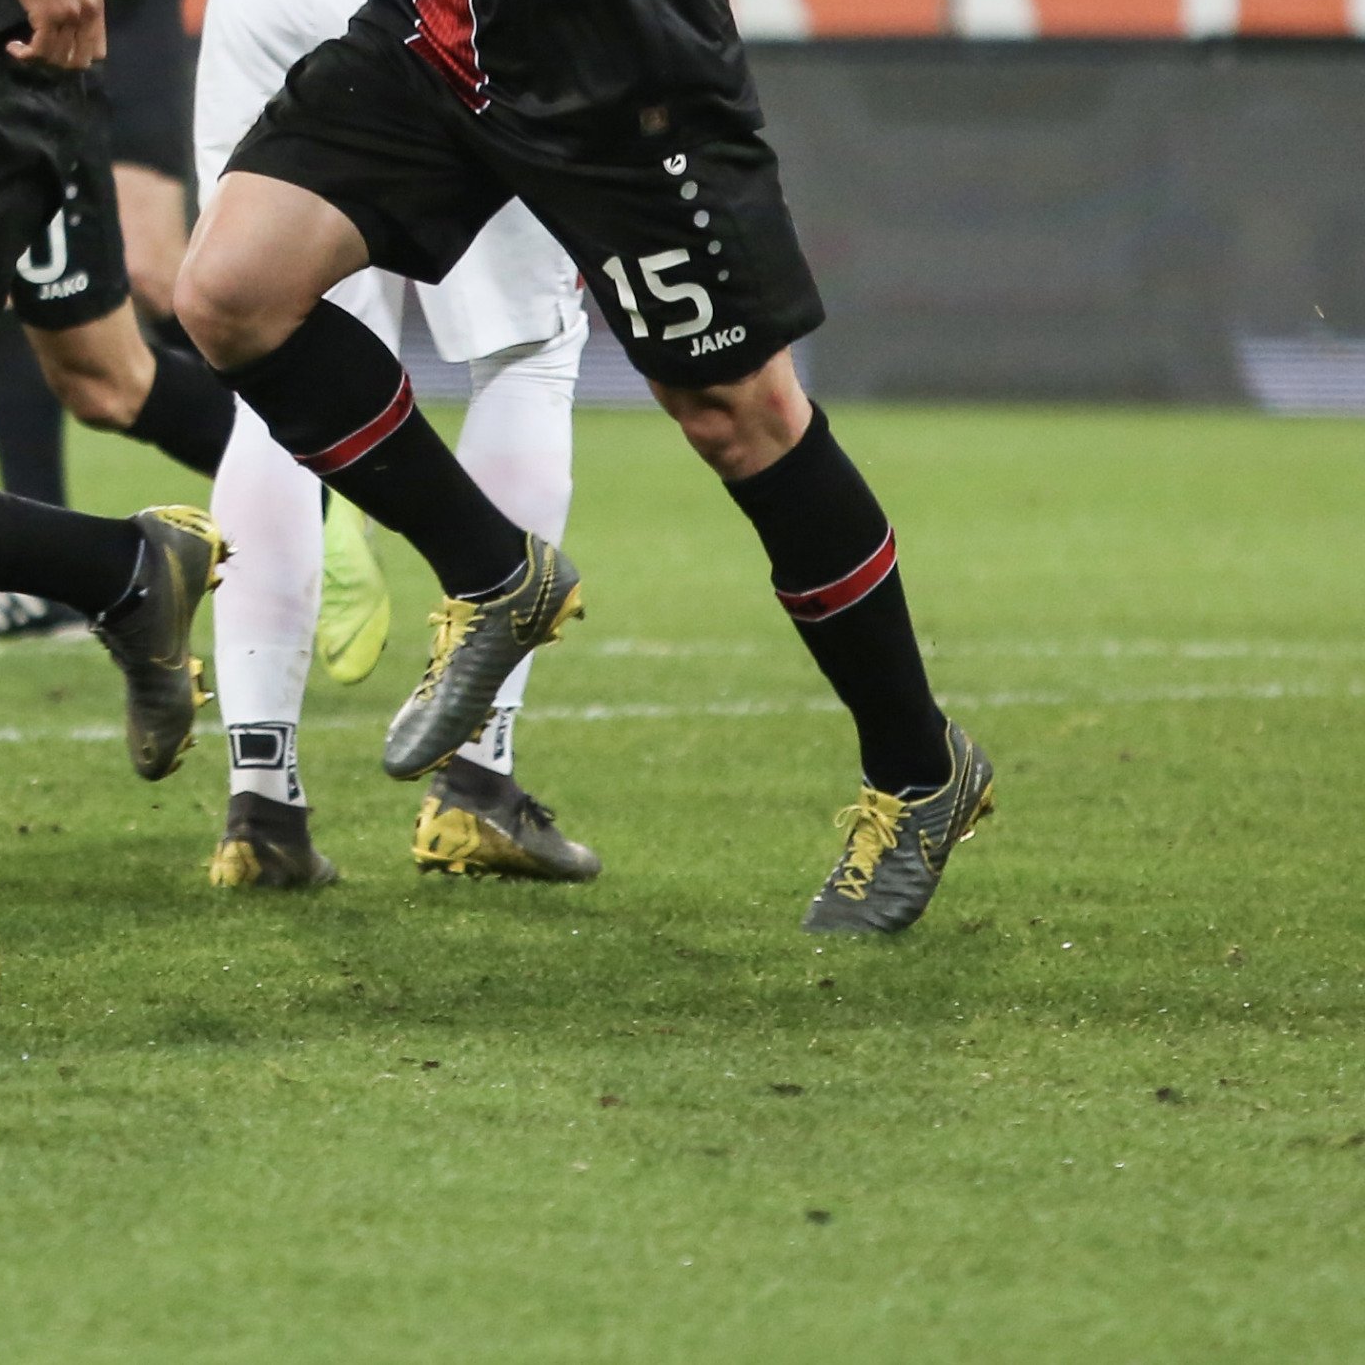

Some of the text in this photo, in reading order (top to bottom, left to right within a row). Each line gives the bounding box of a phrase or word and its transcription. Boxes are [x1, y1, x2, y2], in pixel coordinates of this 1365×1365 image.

[38, 271, 89, 301] JAKO
[601, 247, 714, 341] 15
[690, 325, 747, 357] JAKO
